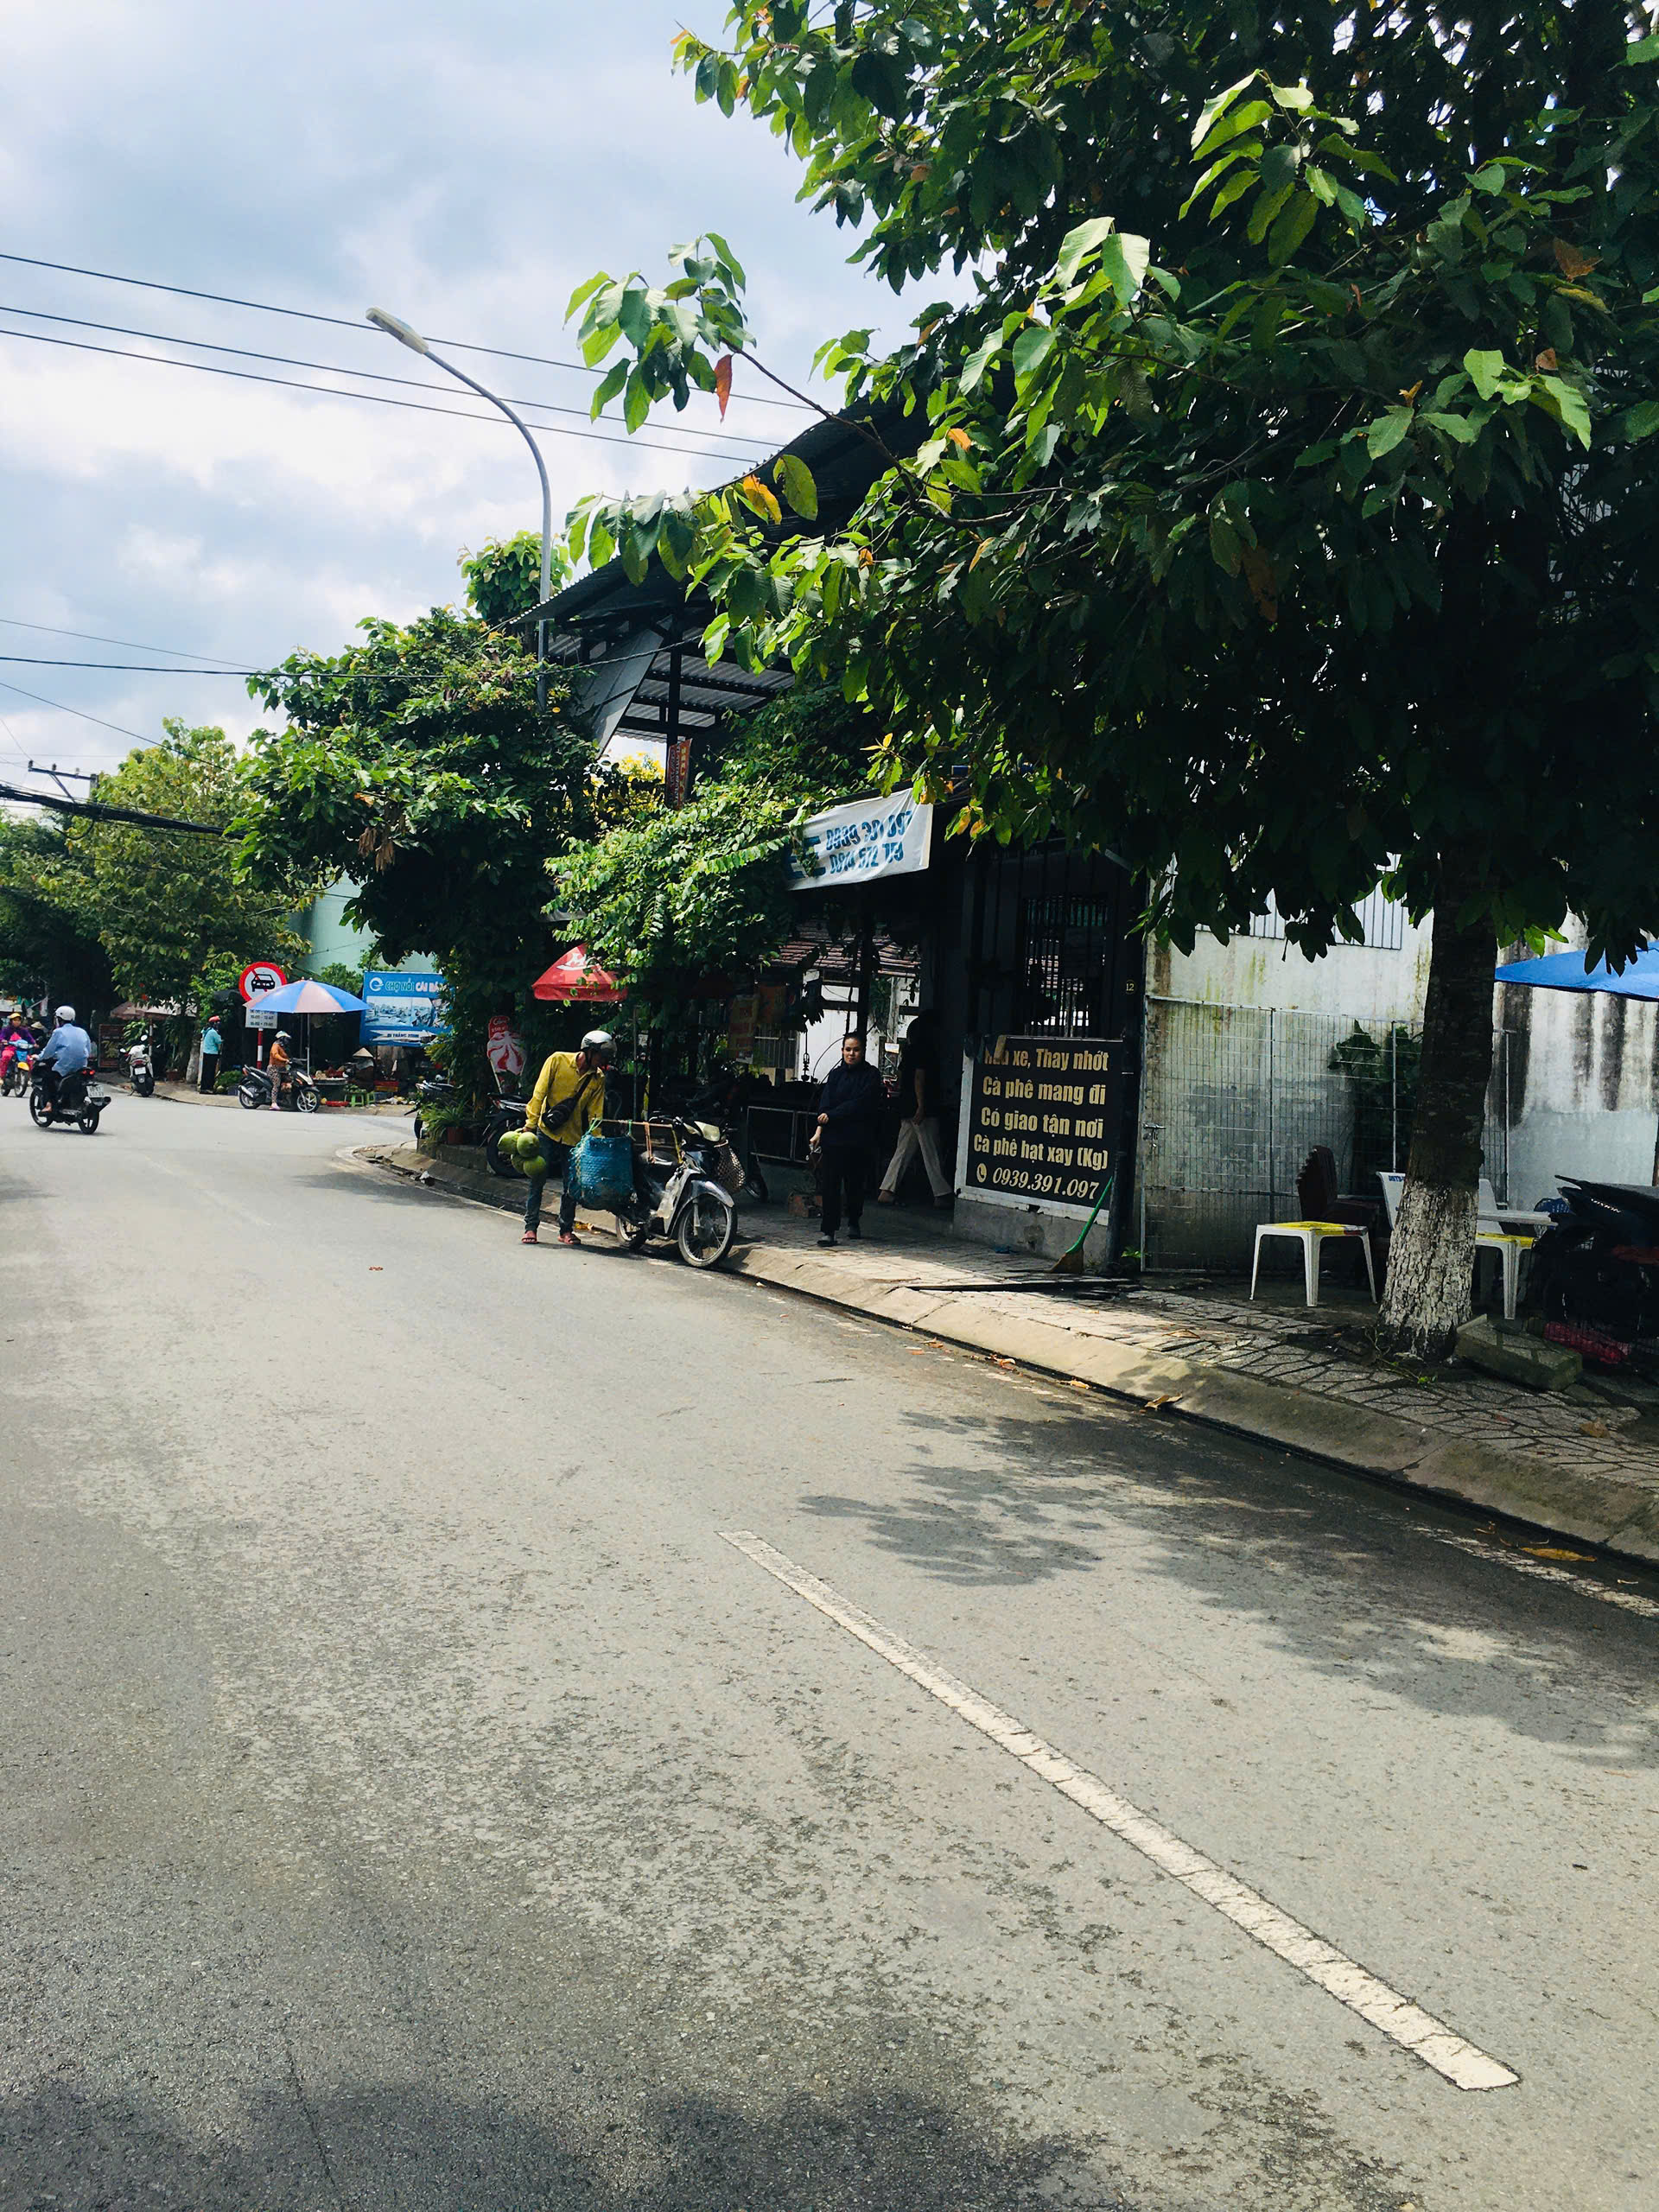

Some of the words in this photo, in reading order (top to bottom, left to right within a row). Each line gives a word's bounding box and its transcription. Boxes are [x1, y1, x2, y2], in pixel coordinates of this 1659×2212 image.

[1126, 982, 1135, 992] 12
[1012, 1051, 1031, 1069] xe,
[1036, 1048, 1068, 1071] Thay
[1073, 1049, 1109, 1071] nhớt
[982, 1076, 1001, 1096] Cà
[1005, 1078, 1034, 1099] phê
[1038, 1082, 1084, 1106] mang
[1089, 1084, 1107, 1105] đi
[981, 1107, 1001, 1127] Có
[1004, 1109, 1038, 1133] giao
[1043, 1113, 1070, 1138] tận
[1075, 1118, 1104, 1140] nơi
[974, 1134, 990, 1154] Cà
[994, 1137, 1018, 1157] phê
[1021, 1141, 1044, 1164] hạt
[1046, 1147, 1074, 1167] xay
[992, 1166, 1100, 1201] 0939.391.097
